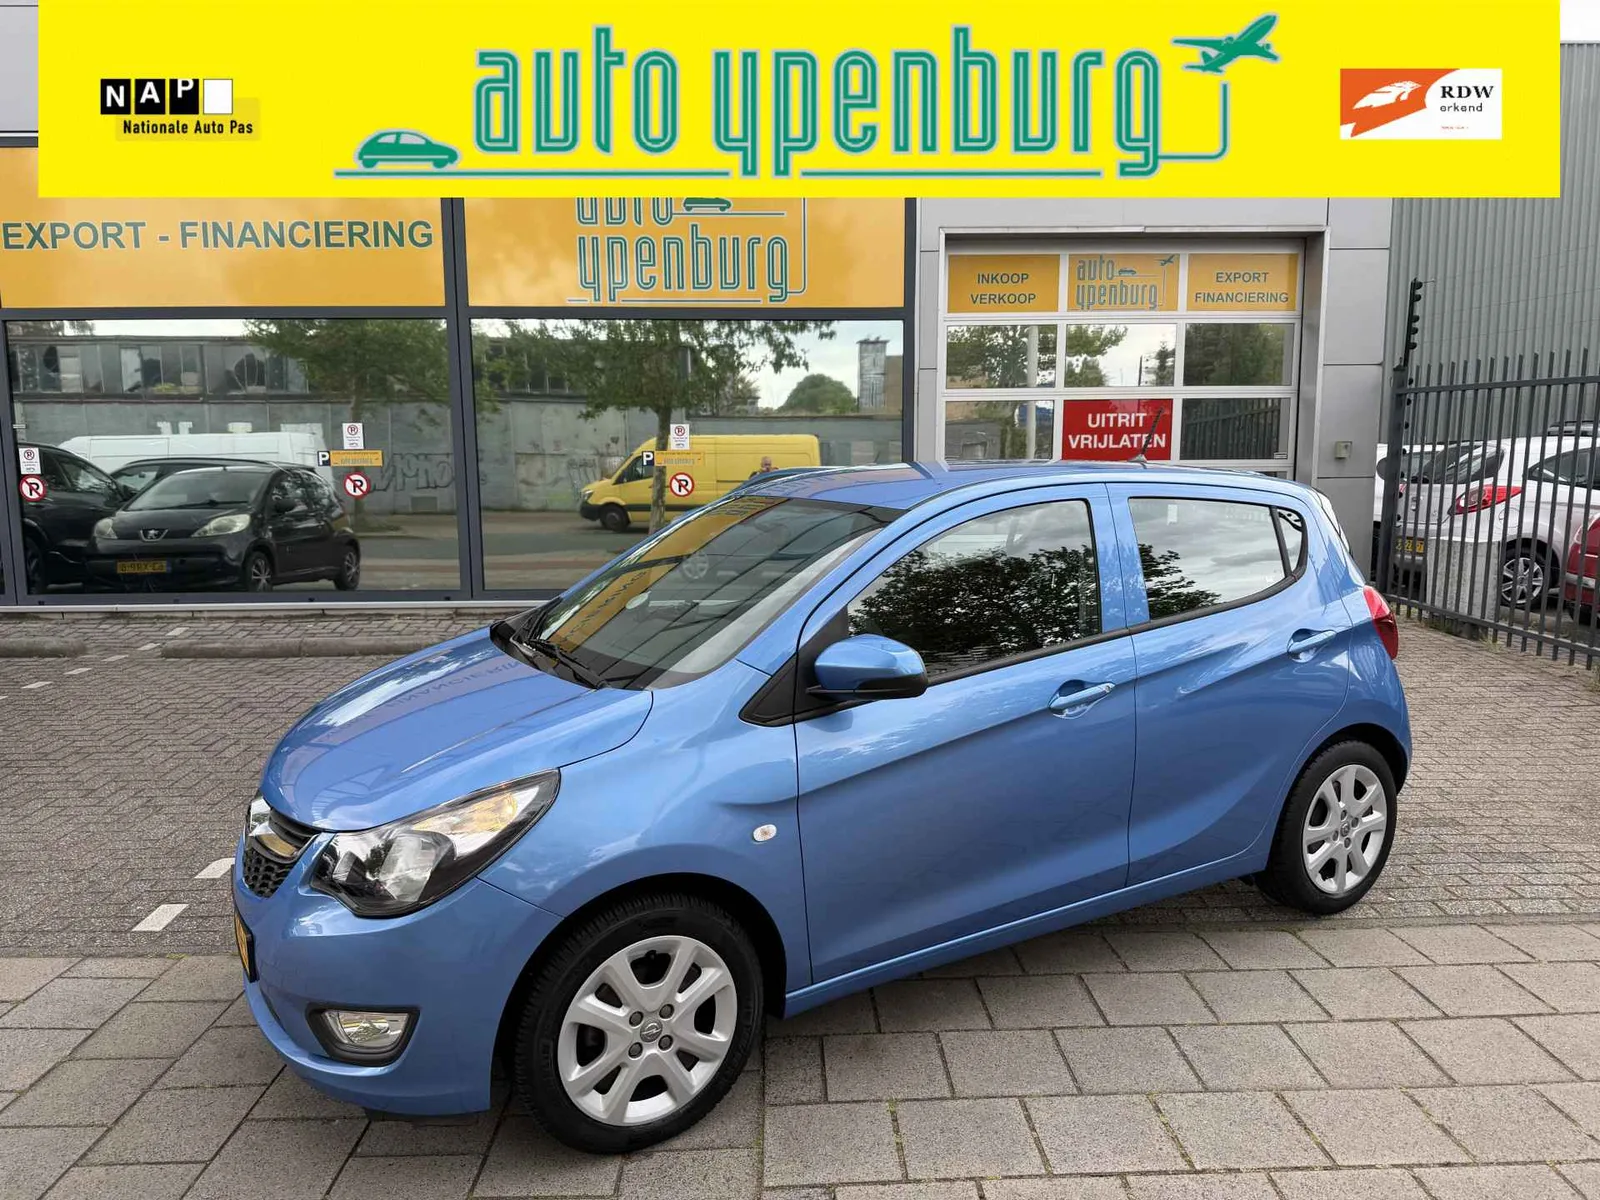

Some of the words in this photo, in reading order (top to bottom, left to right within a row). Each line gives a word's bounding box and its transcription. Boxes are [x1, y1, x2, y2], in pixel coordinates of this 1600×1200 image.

[1, 221, 147, 250] EXPORT
[179, 219, 434, 249] FINANCIERING
[576, 222, 789, 303] ypenburg
[1076, 254, 1115, 281] auto
[976, 272, 1030, 285] INKOOP
[1215, 271, 1269, 283] EXPORT
[970, 292, 1037, 305] VERKOOP
[1076, 280, 1158, 311] ypenburg
[1194, 292, 1290, 303] FINANCIERING
[1087, 412, 1148, 428] UITRIT
[1068, 433, 1167, 449] VRIJLATEN
[318, 451, 330, 466] P
[642, 451, 654, 466] P
